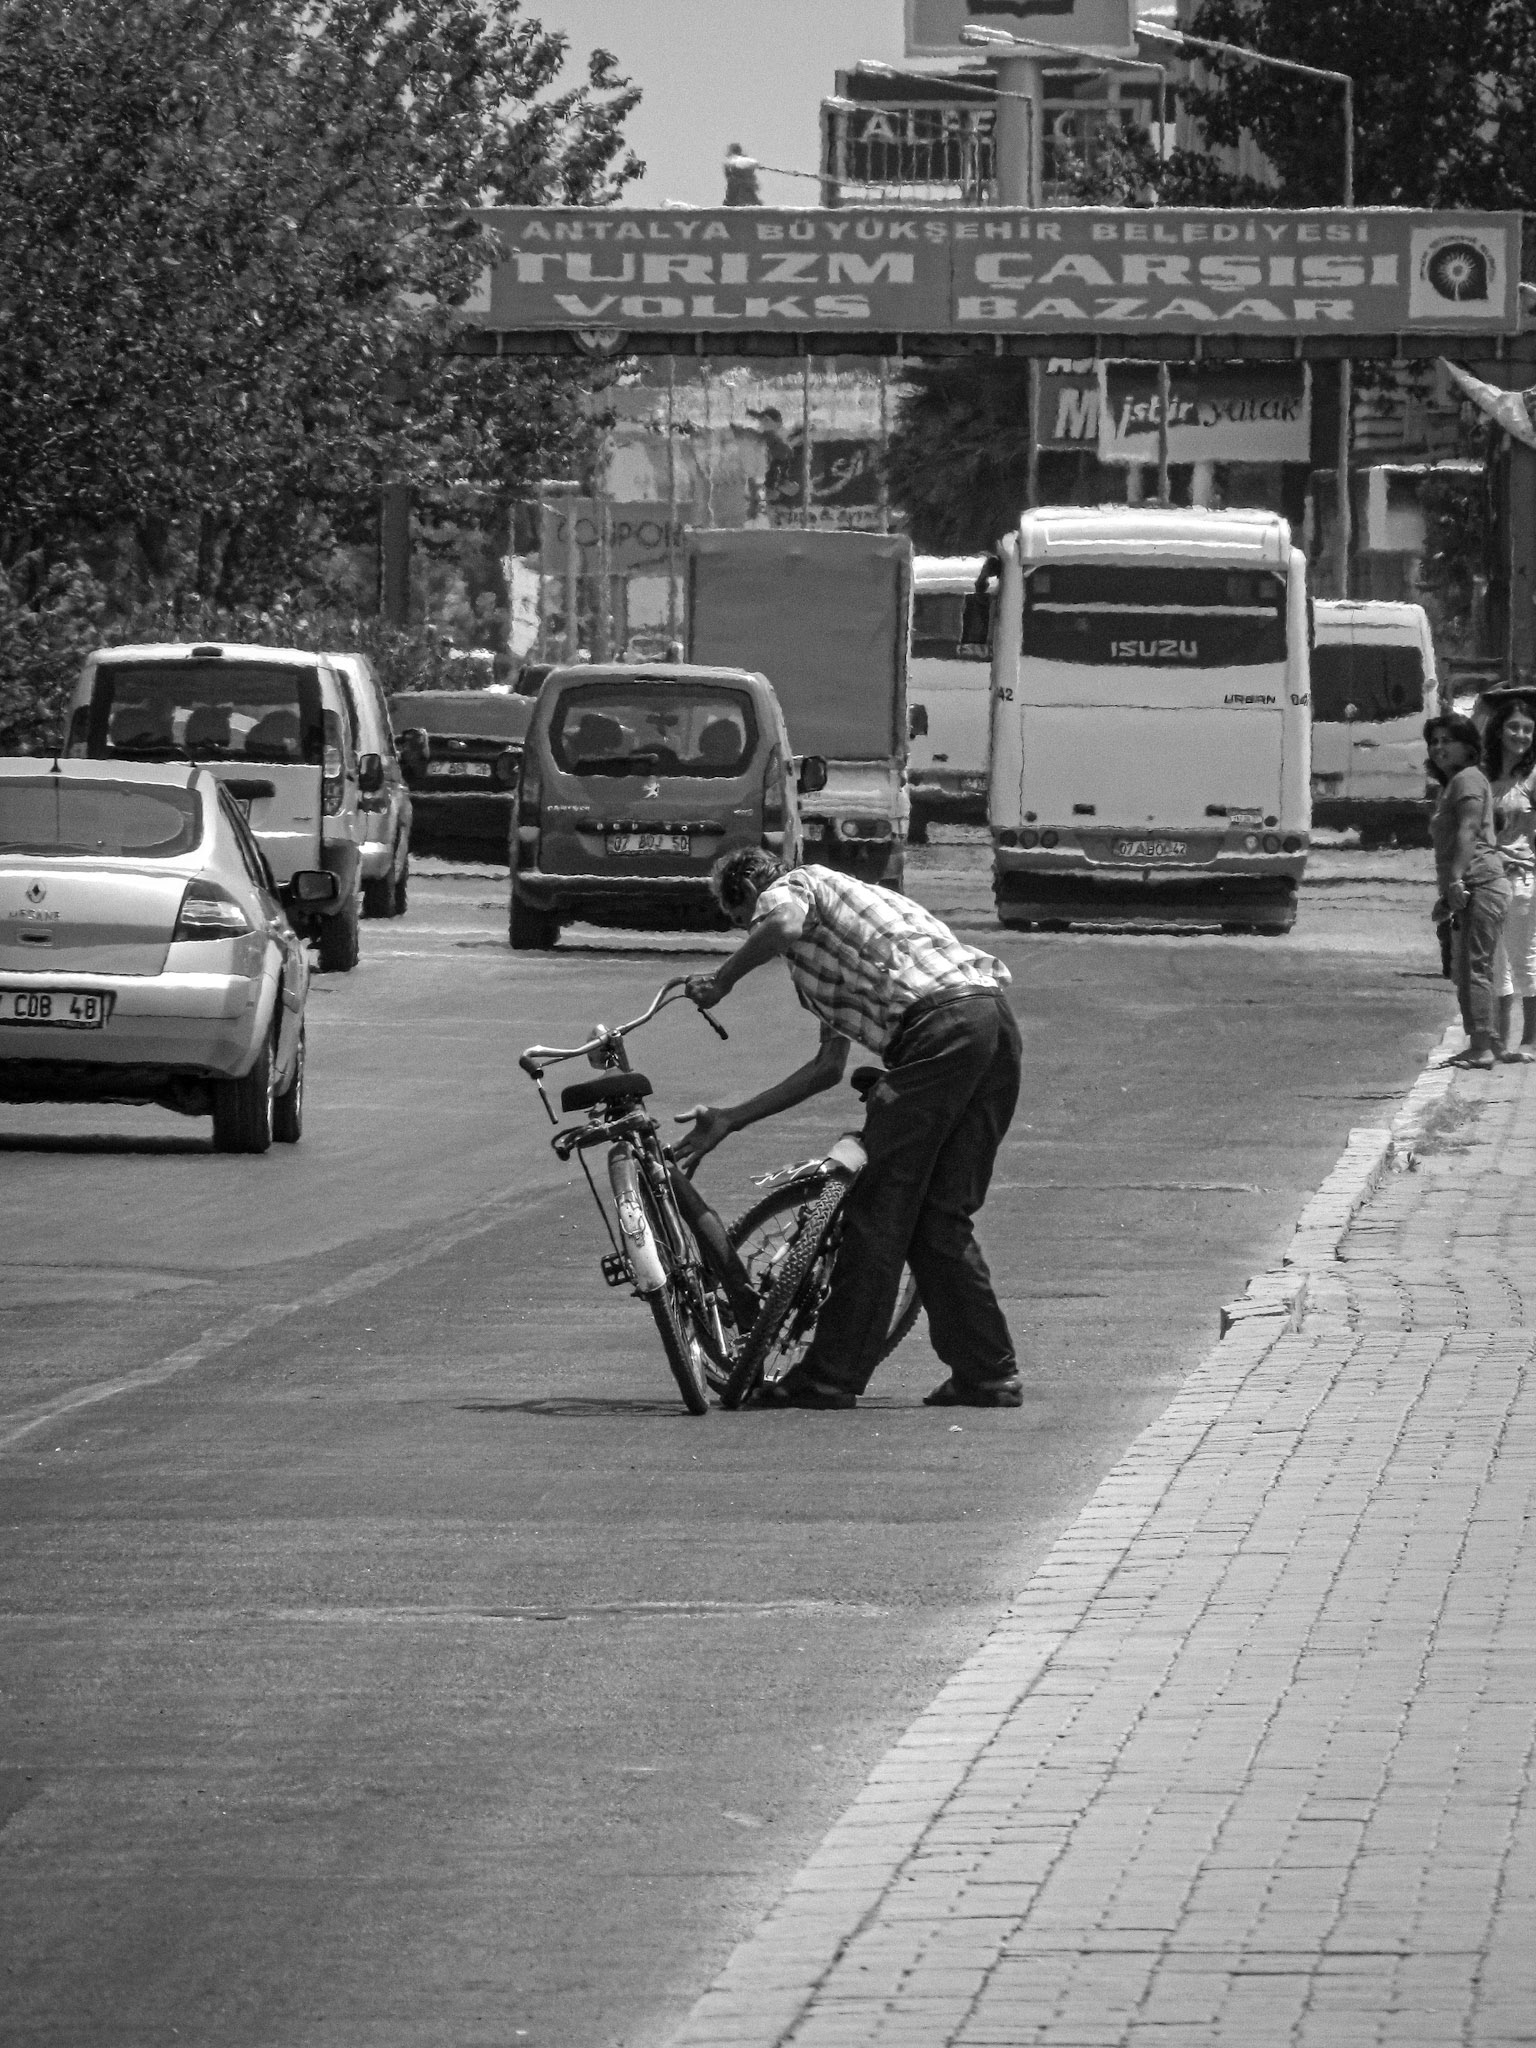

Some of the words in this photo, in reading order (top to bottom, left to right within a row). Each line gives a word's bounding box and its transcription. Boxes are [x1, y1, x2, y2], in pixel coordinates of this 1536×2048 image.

[520, 220, 731, 241] ANTALYA
[756, 216, 1063, 244] BÜYÜKŞEHİR
[1091, 217, 1369, 243] BELEDİYESİ
[974, 252, 1399, 292] ÇARŞISI
[554, 294, 871, 318] VOLKS
[957, 296, 1355, 321] BAZAAR
[1111, 639, 1198, 658] ISUZU
[69, 996, 97, 1020] 48
